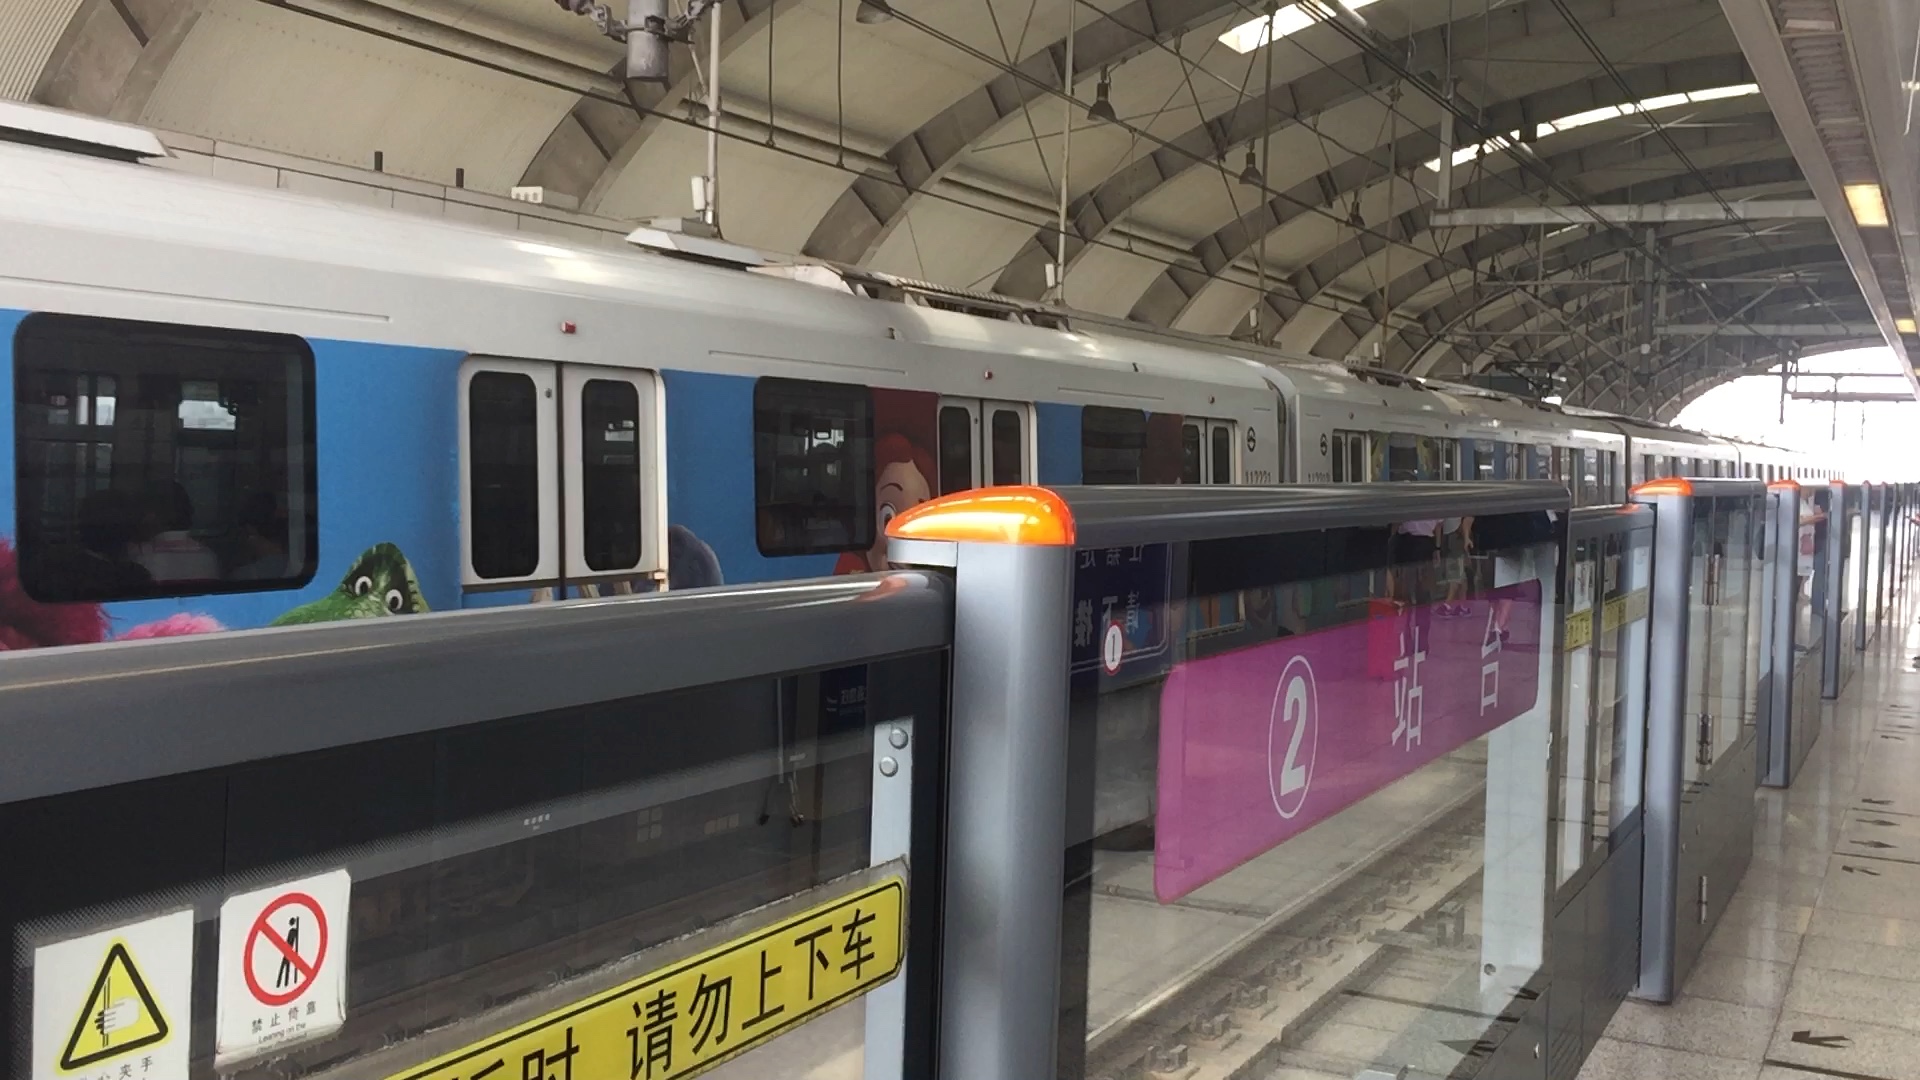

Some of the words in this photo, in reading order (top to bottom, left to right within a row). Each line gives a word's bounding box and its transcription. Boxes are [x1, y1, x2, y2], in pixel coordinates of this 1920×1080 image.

[1391, 606, 1499, 753] 站台
[252, 1001, 316, 1034] 禁止倚靠
[627, 908, 877, 1080] 请勿上下车
